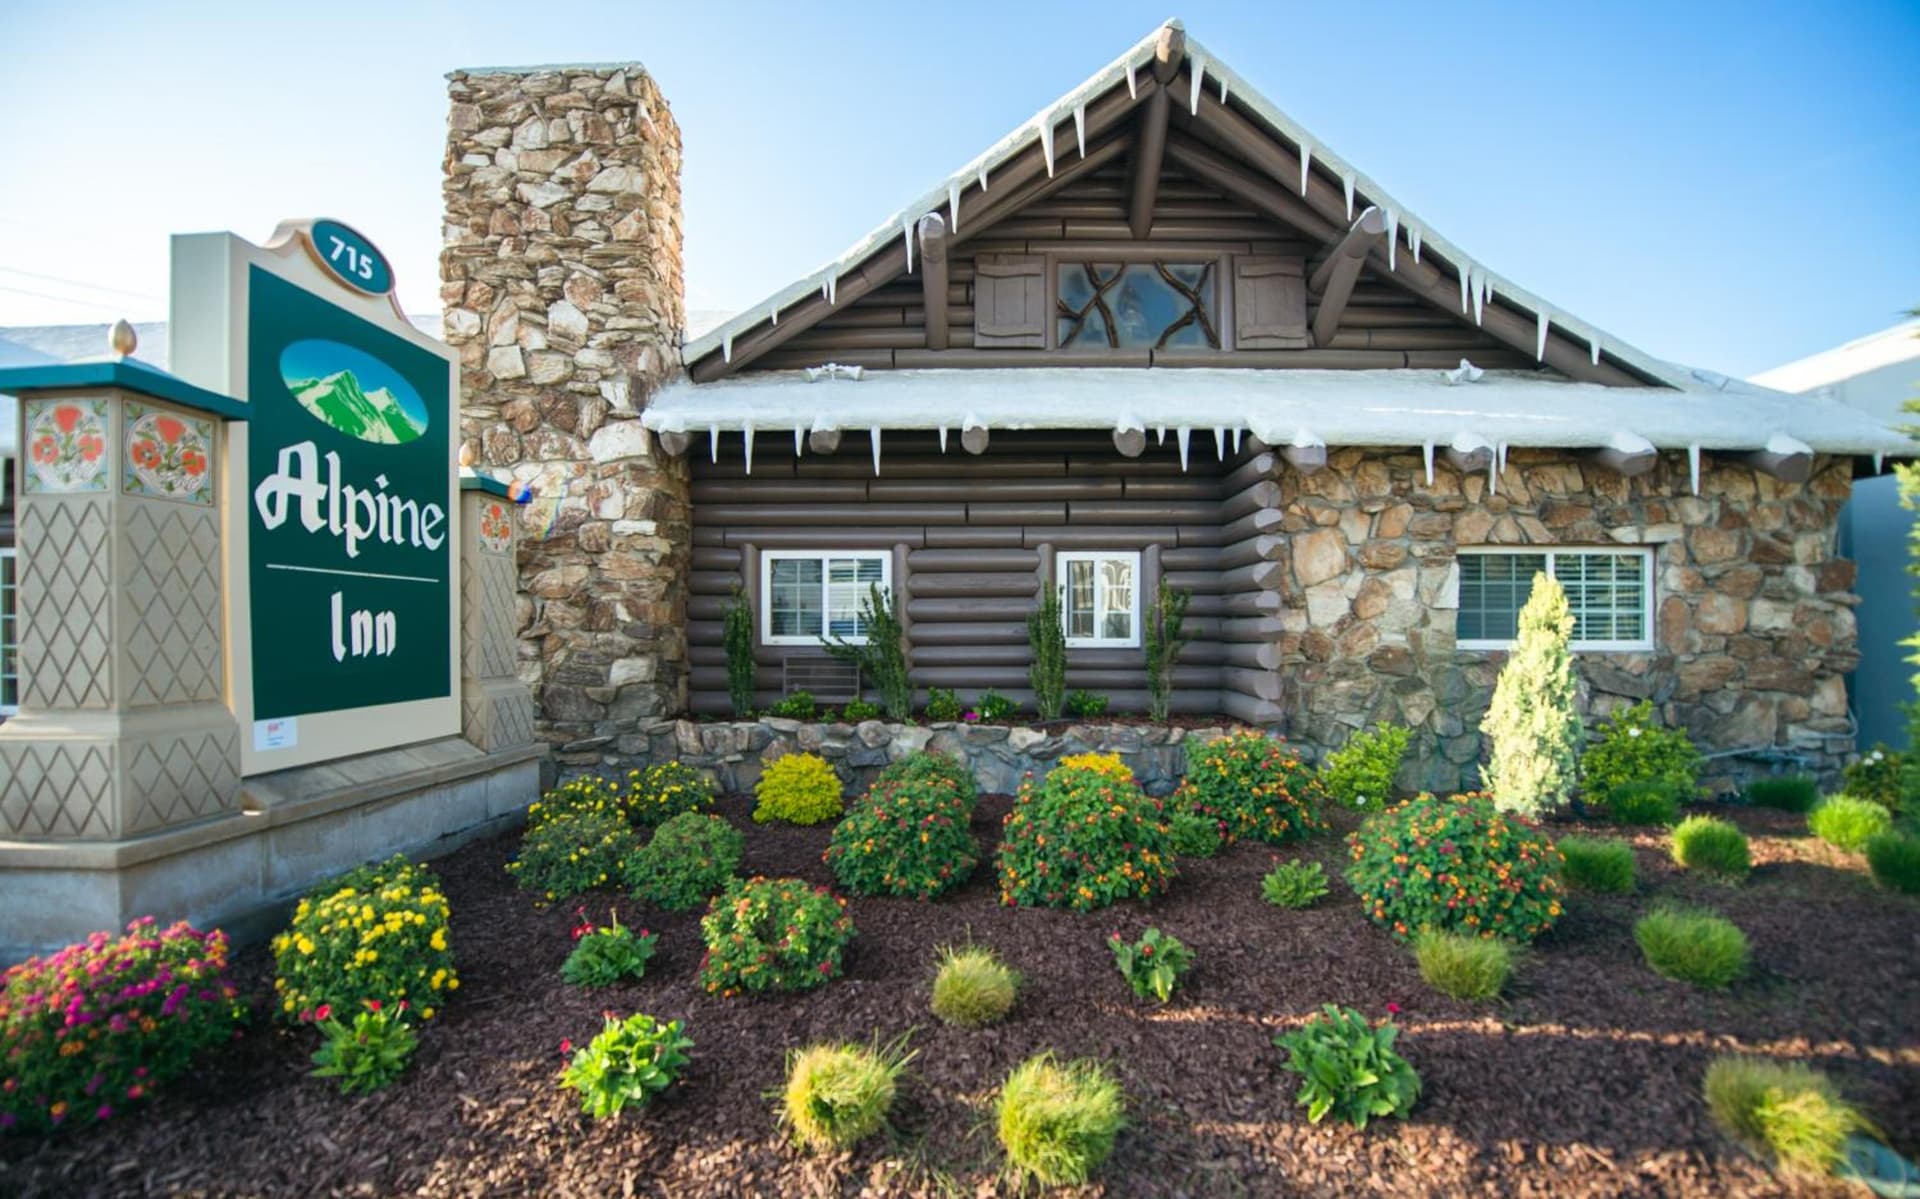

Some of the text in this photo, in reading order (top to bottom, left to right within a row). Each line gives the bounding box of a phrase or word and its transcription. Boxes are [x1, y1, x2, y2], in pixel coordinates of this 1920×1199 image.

[330, 236, 373, 279] 715
[254, 440, 445, 558] Alpine
[331, 591, 396, 662] Inn
